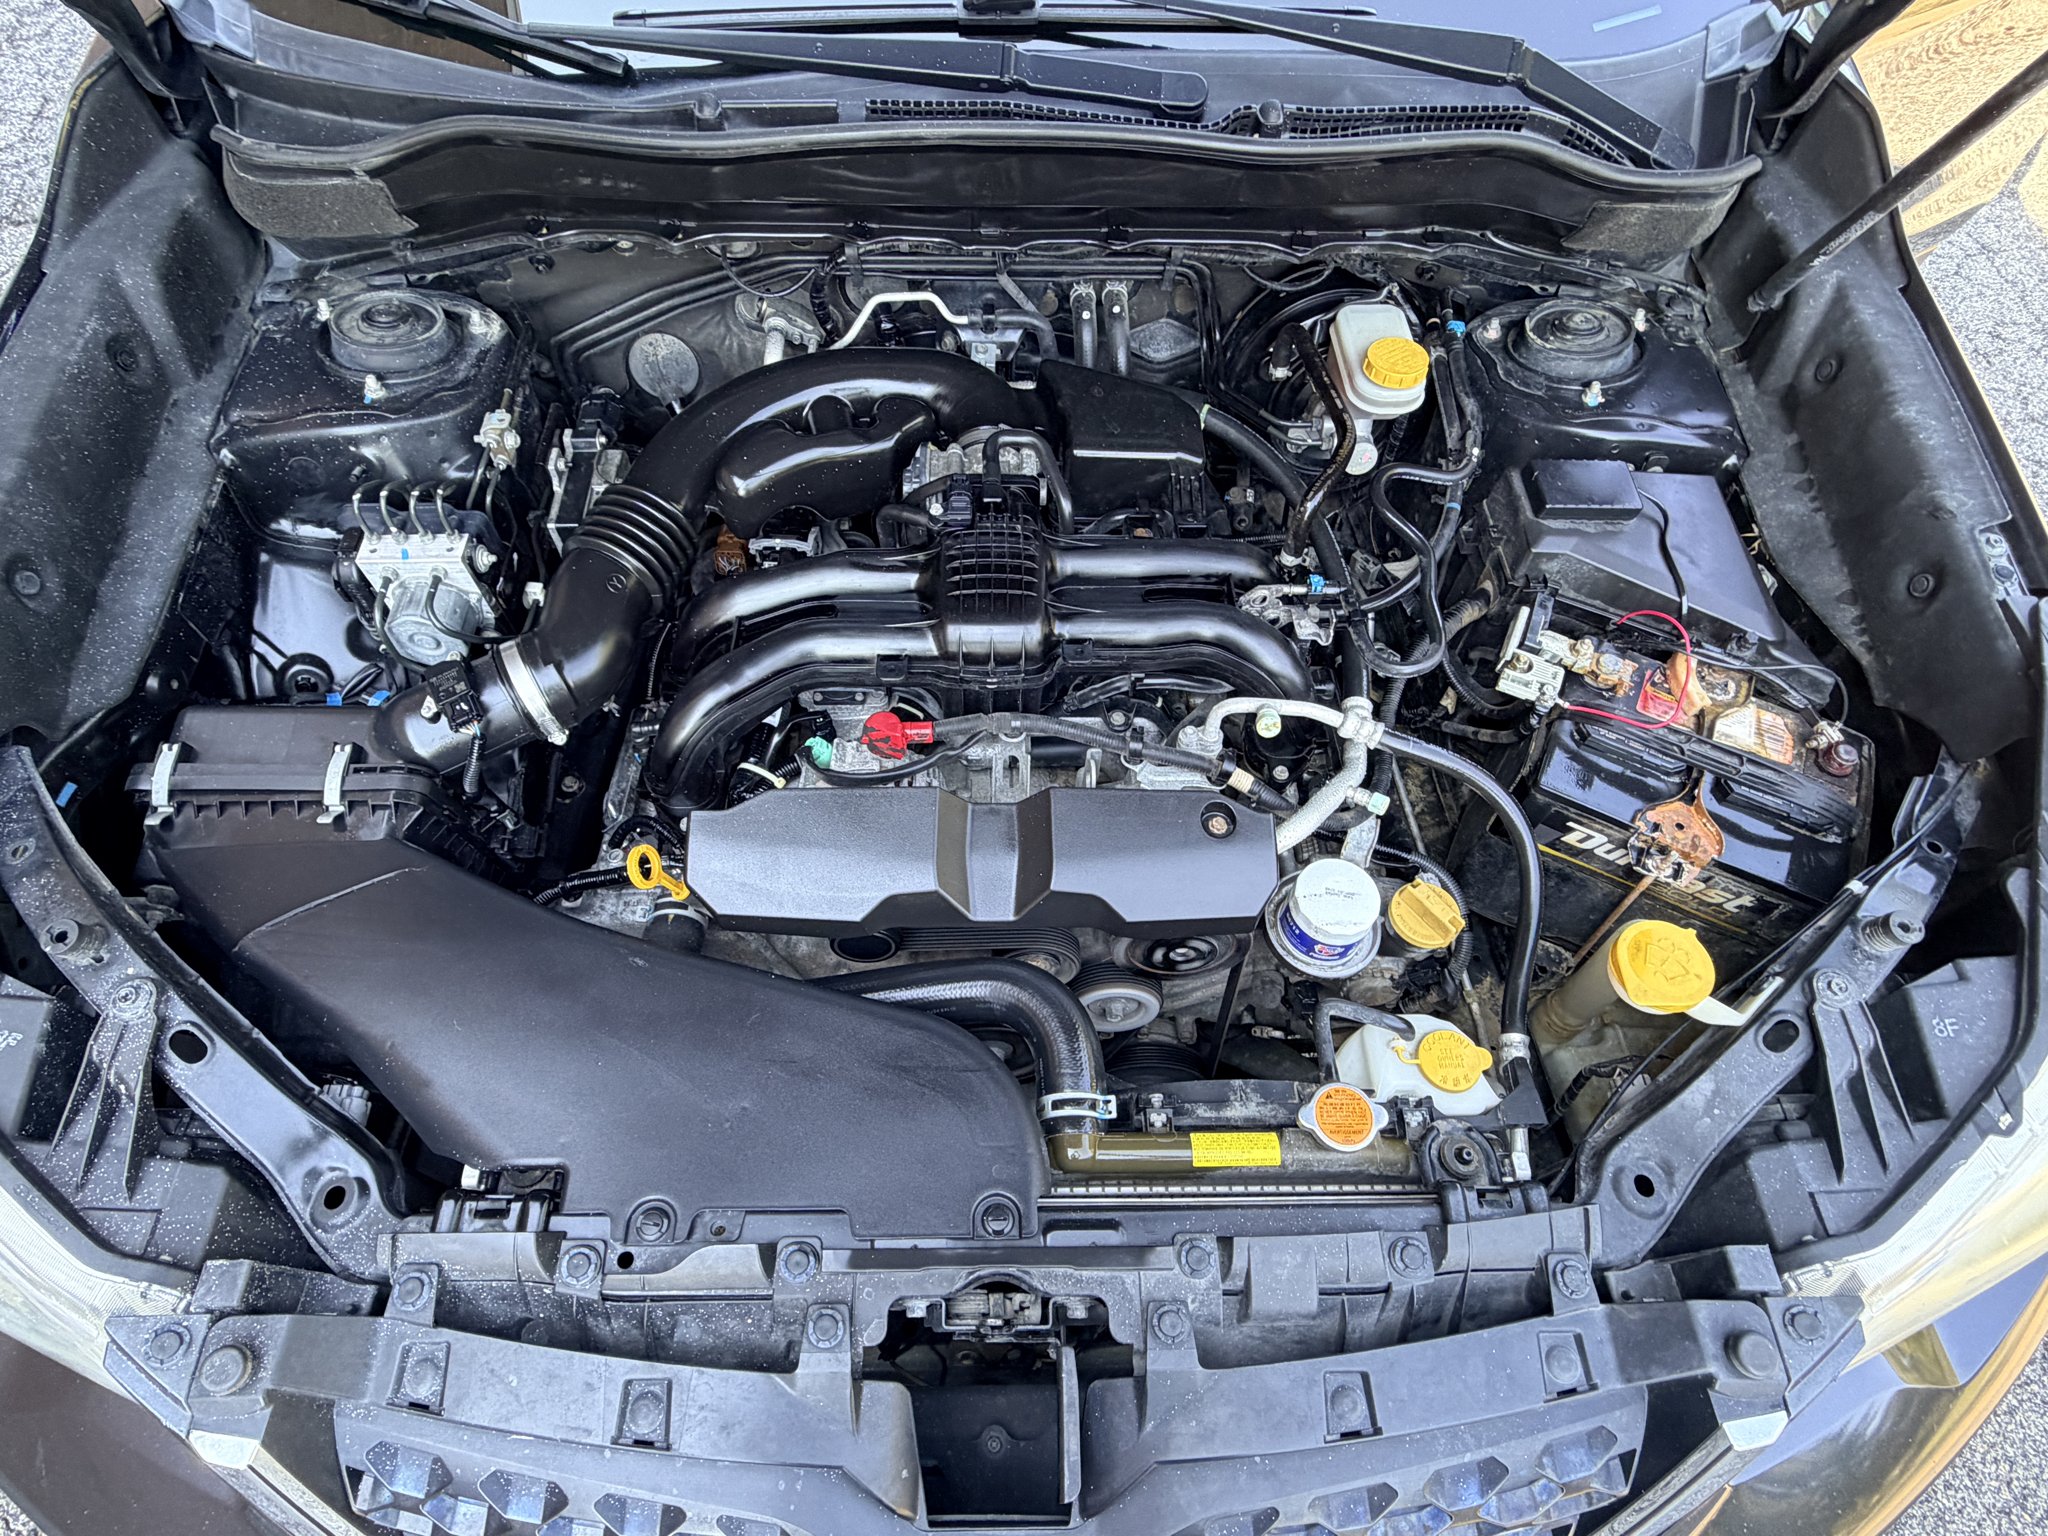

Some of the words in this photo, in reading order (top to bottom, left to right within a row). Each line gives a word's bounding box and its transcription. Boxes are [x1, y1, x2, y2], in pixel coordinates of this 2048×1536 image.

[1560, 821, 1758, 914] Durast
[1931, 1017, 1960, 1038] 8F
[1422, 1032, 1471, 1053] COOLANT
